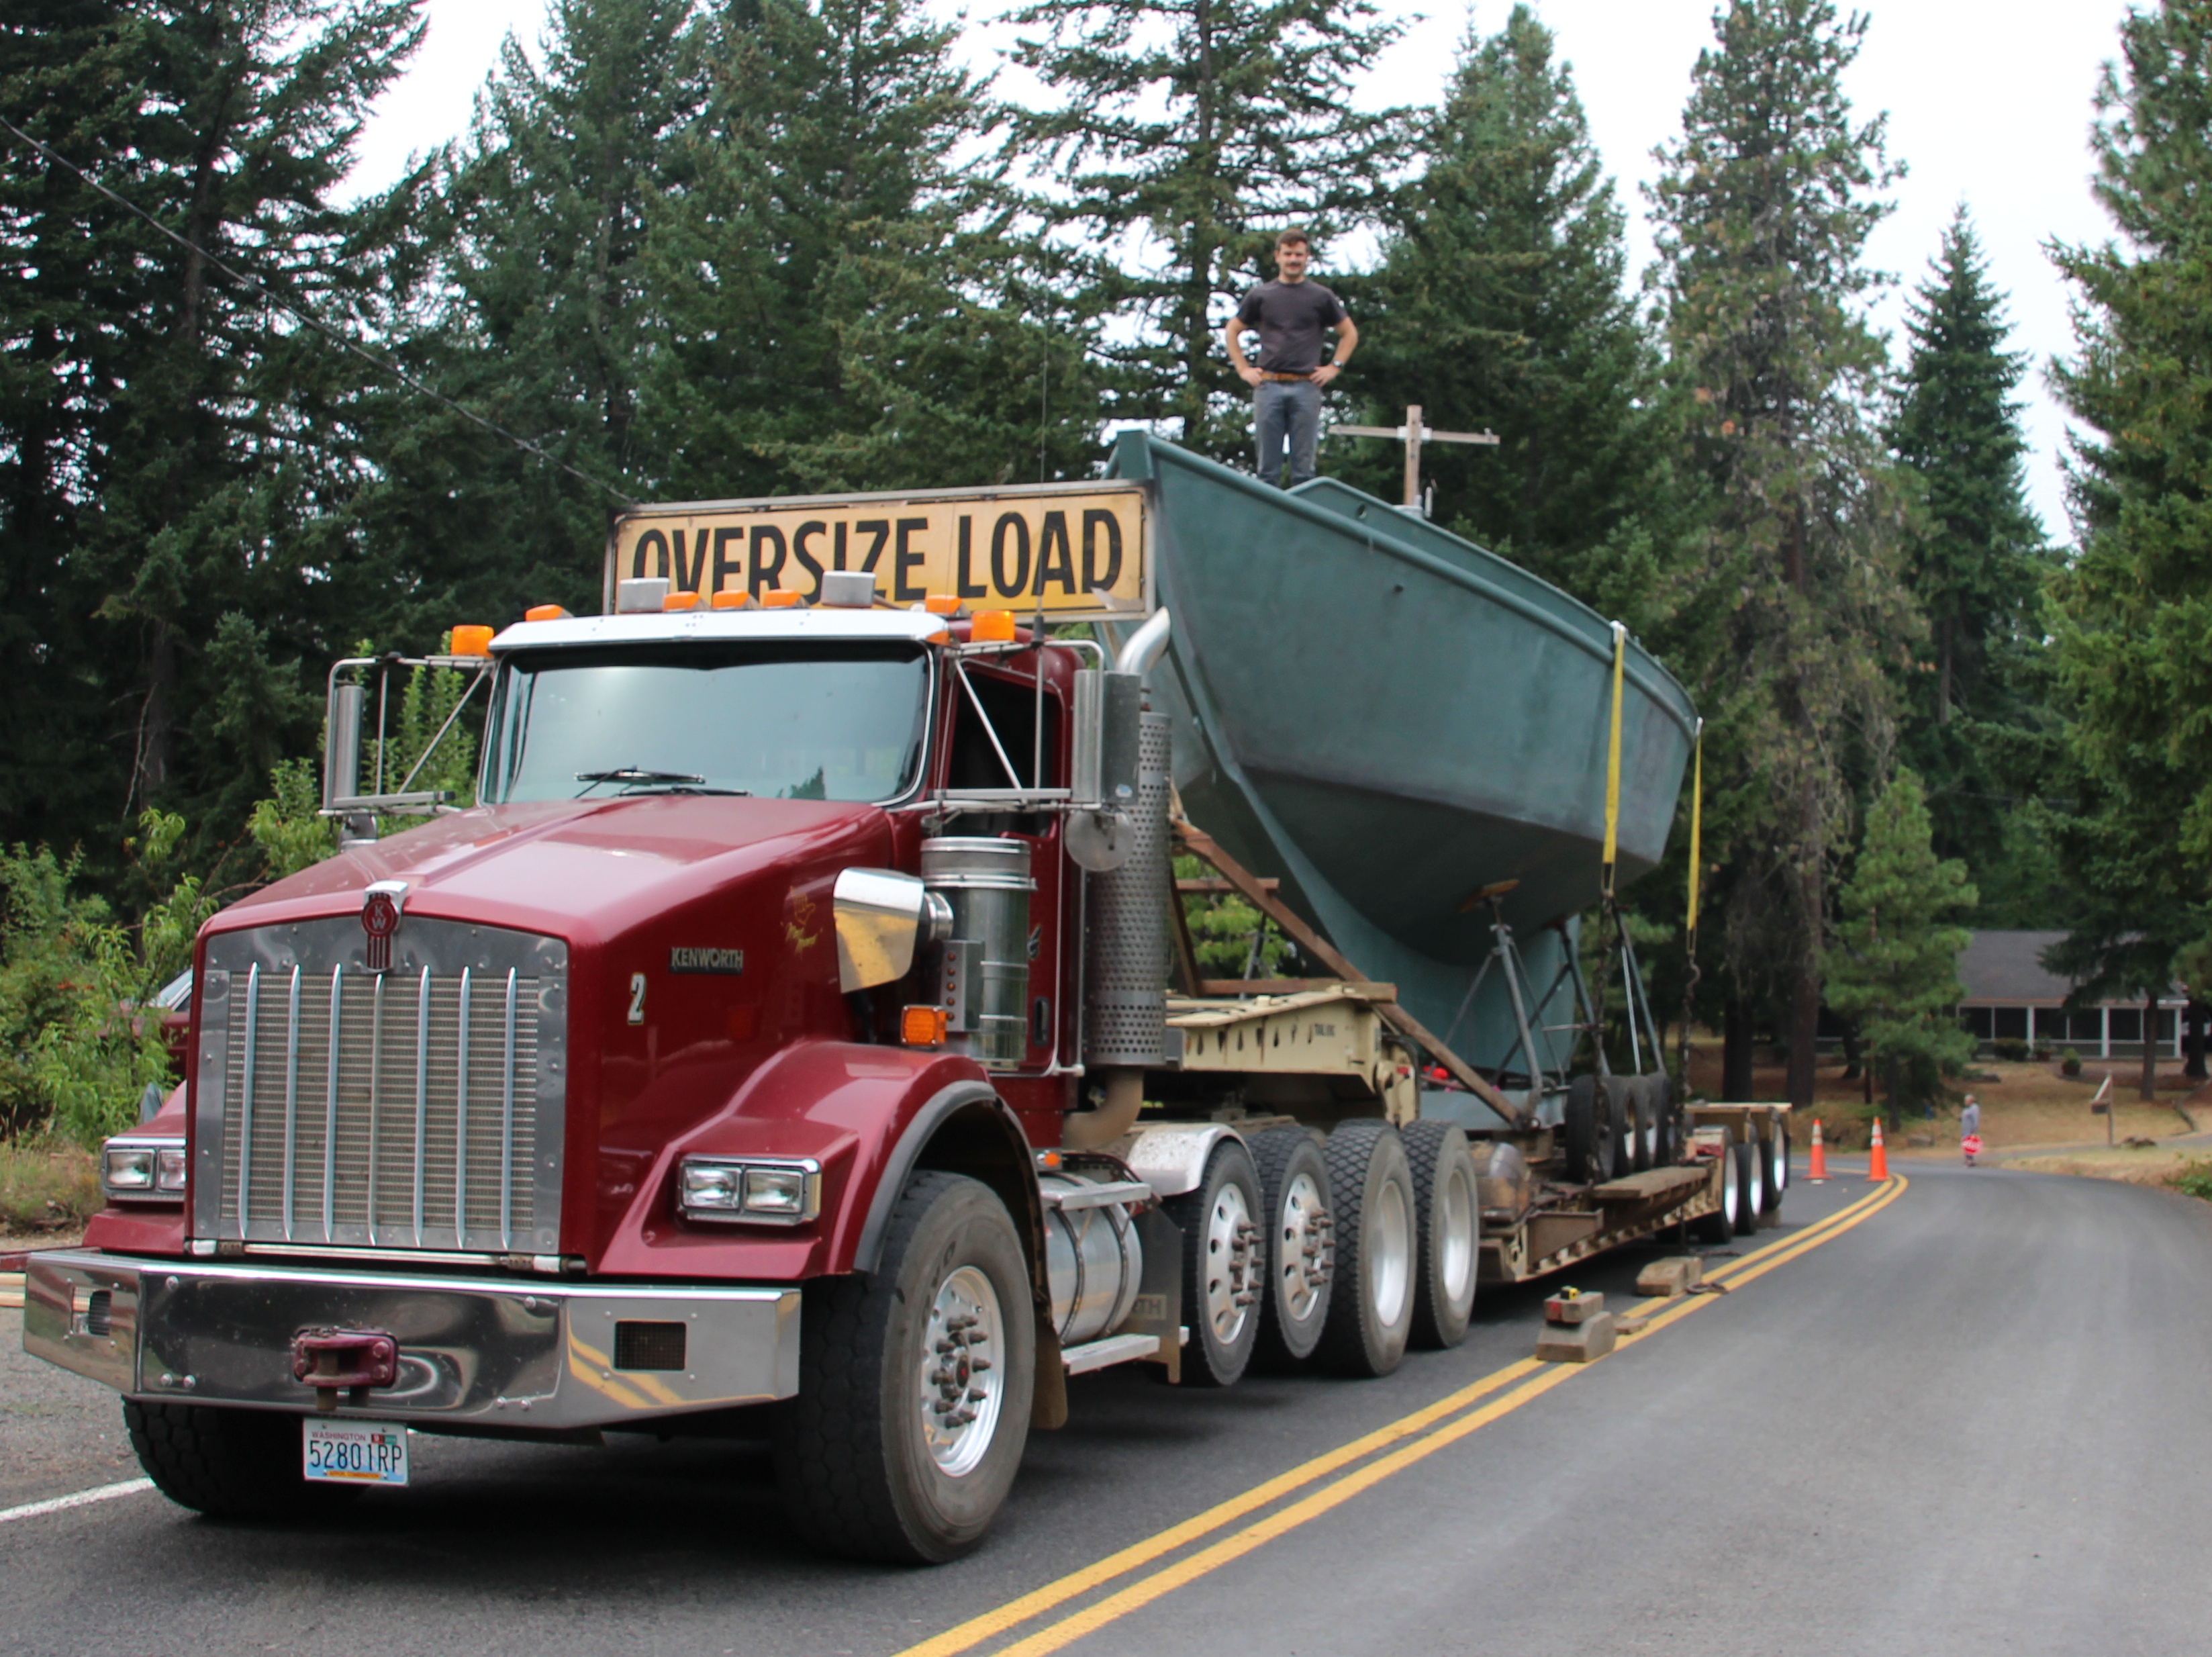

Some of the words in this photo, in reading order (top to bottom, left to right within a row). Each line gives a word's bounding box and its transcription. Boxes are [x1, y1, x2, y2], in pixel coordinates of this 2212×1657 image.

[632, 517, 929, 609] OVERSIZE
[957, 508, 1123, 600] LOAD
[671, 947, 744, 969] KENWORTH
[627, 972, 646, 1025] 2
[311, 1431, 367, 1441] WASHINGTON
[309, 1440, 402, 1473] 52801RP
